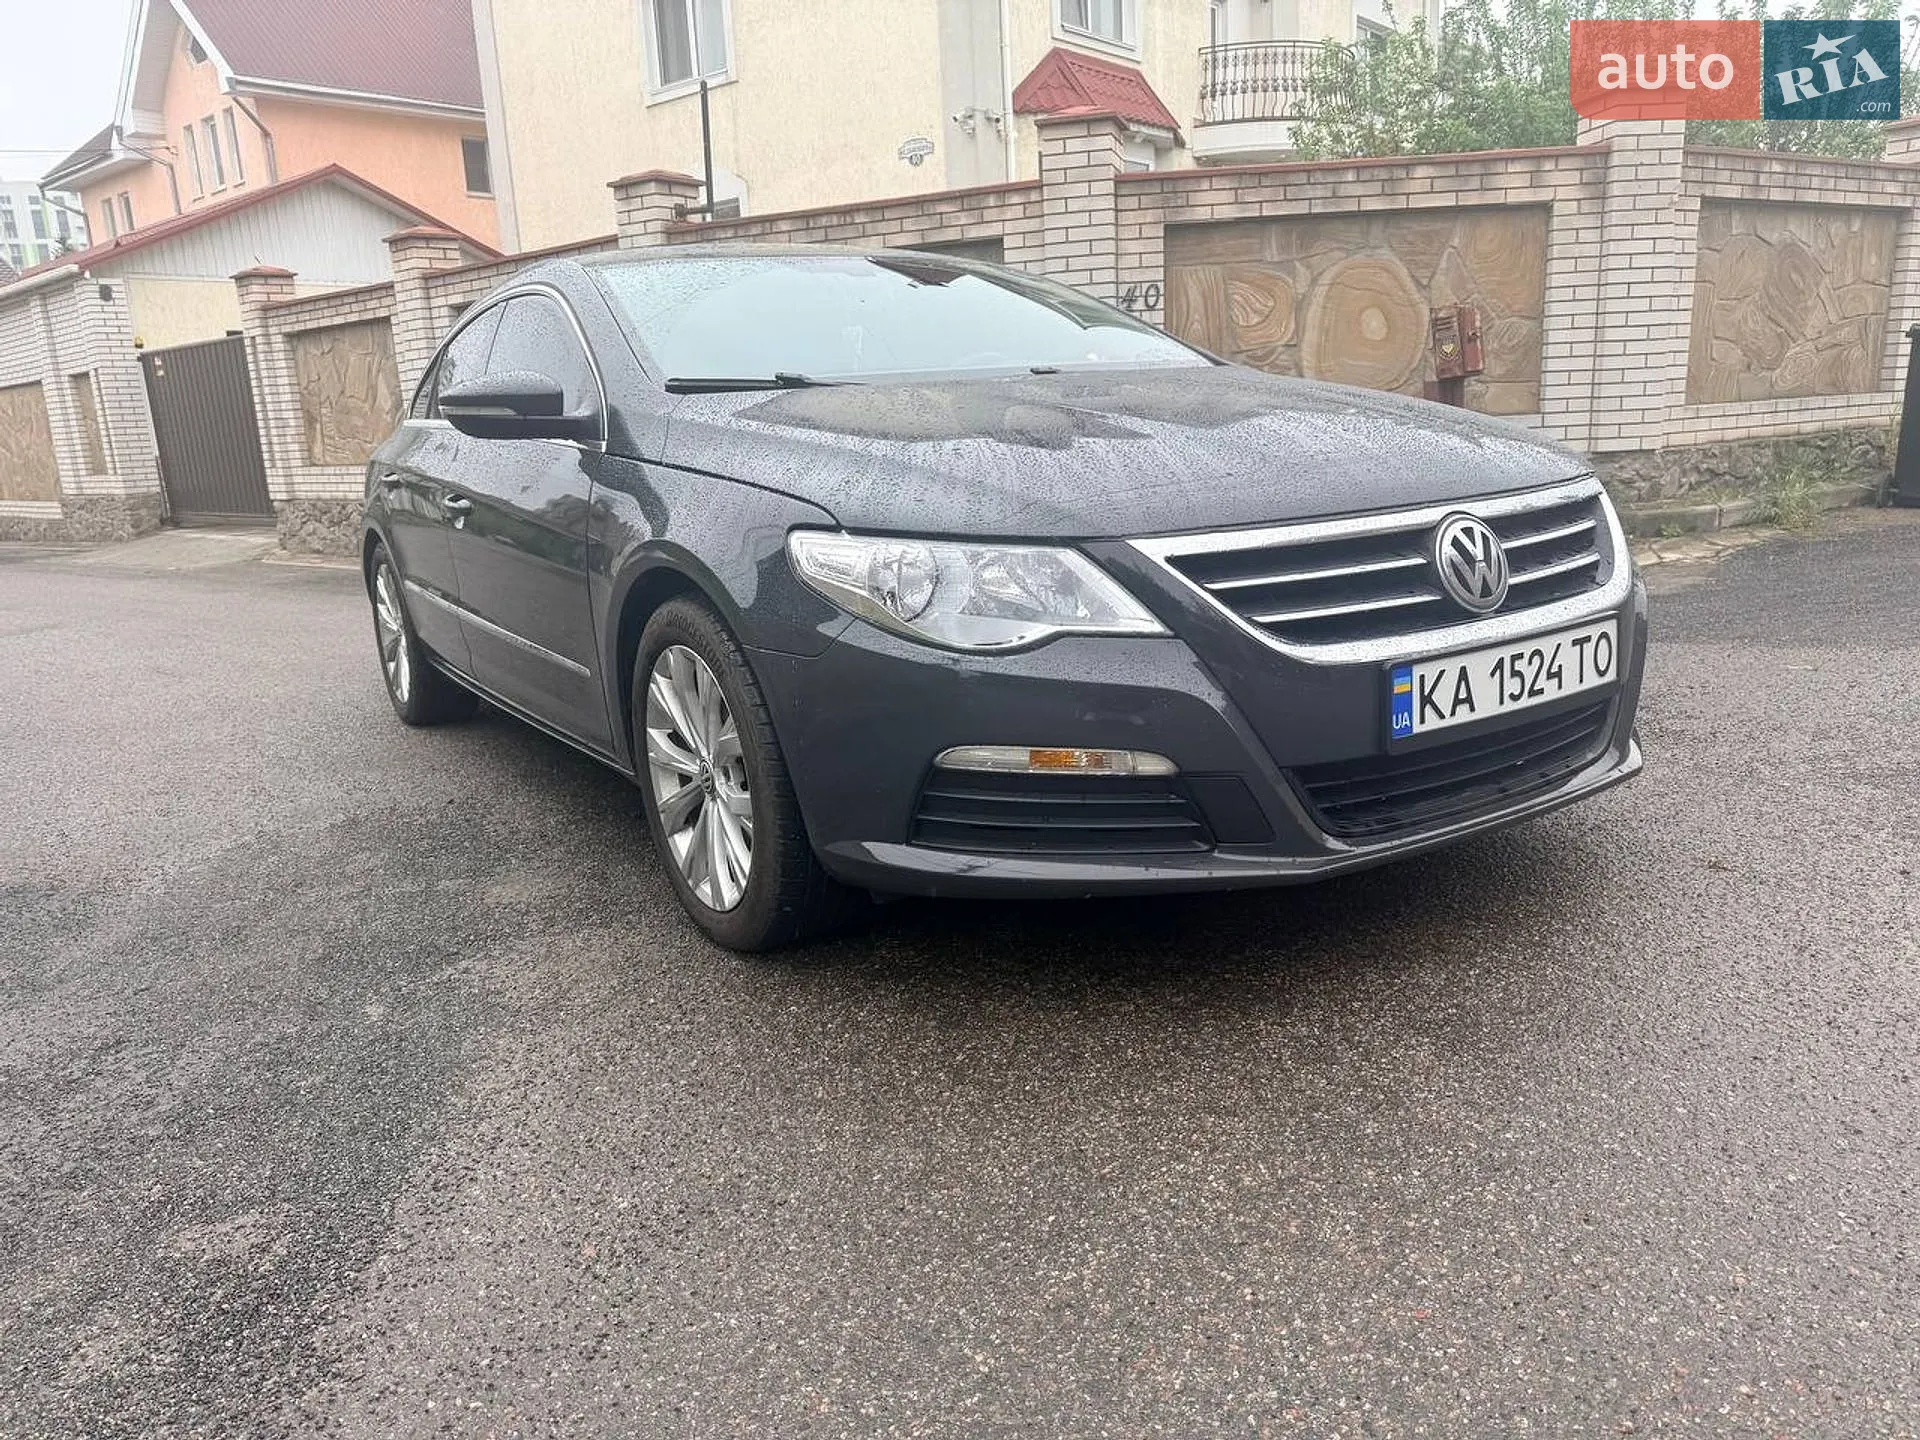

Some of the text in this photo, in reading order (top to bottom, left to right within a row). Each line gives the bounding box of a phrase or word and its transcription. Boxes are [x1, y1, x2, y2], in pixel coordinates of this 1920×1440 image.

[1121, 283, 1160, 309] 40
[1419, 631, 1613, 725] KA 1524 TO
[1393, 712, 1411, 729] UA
